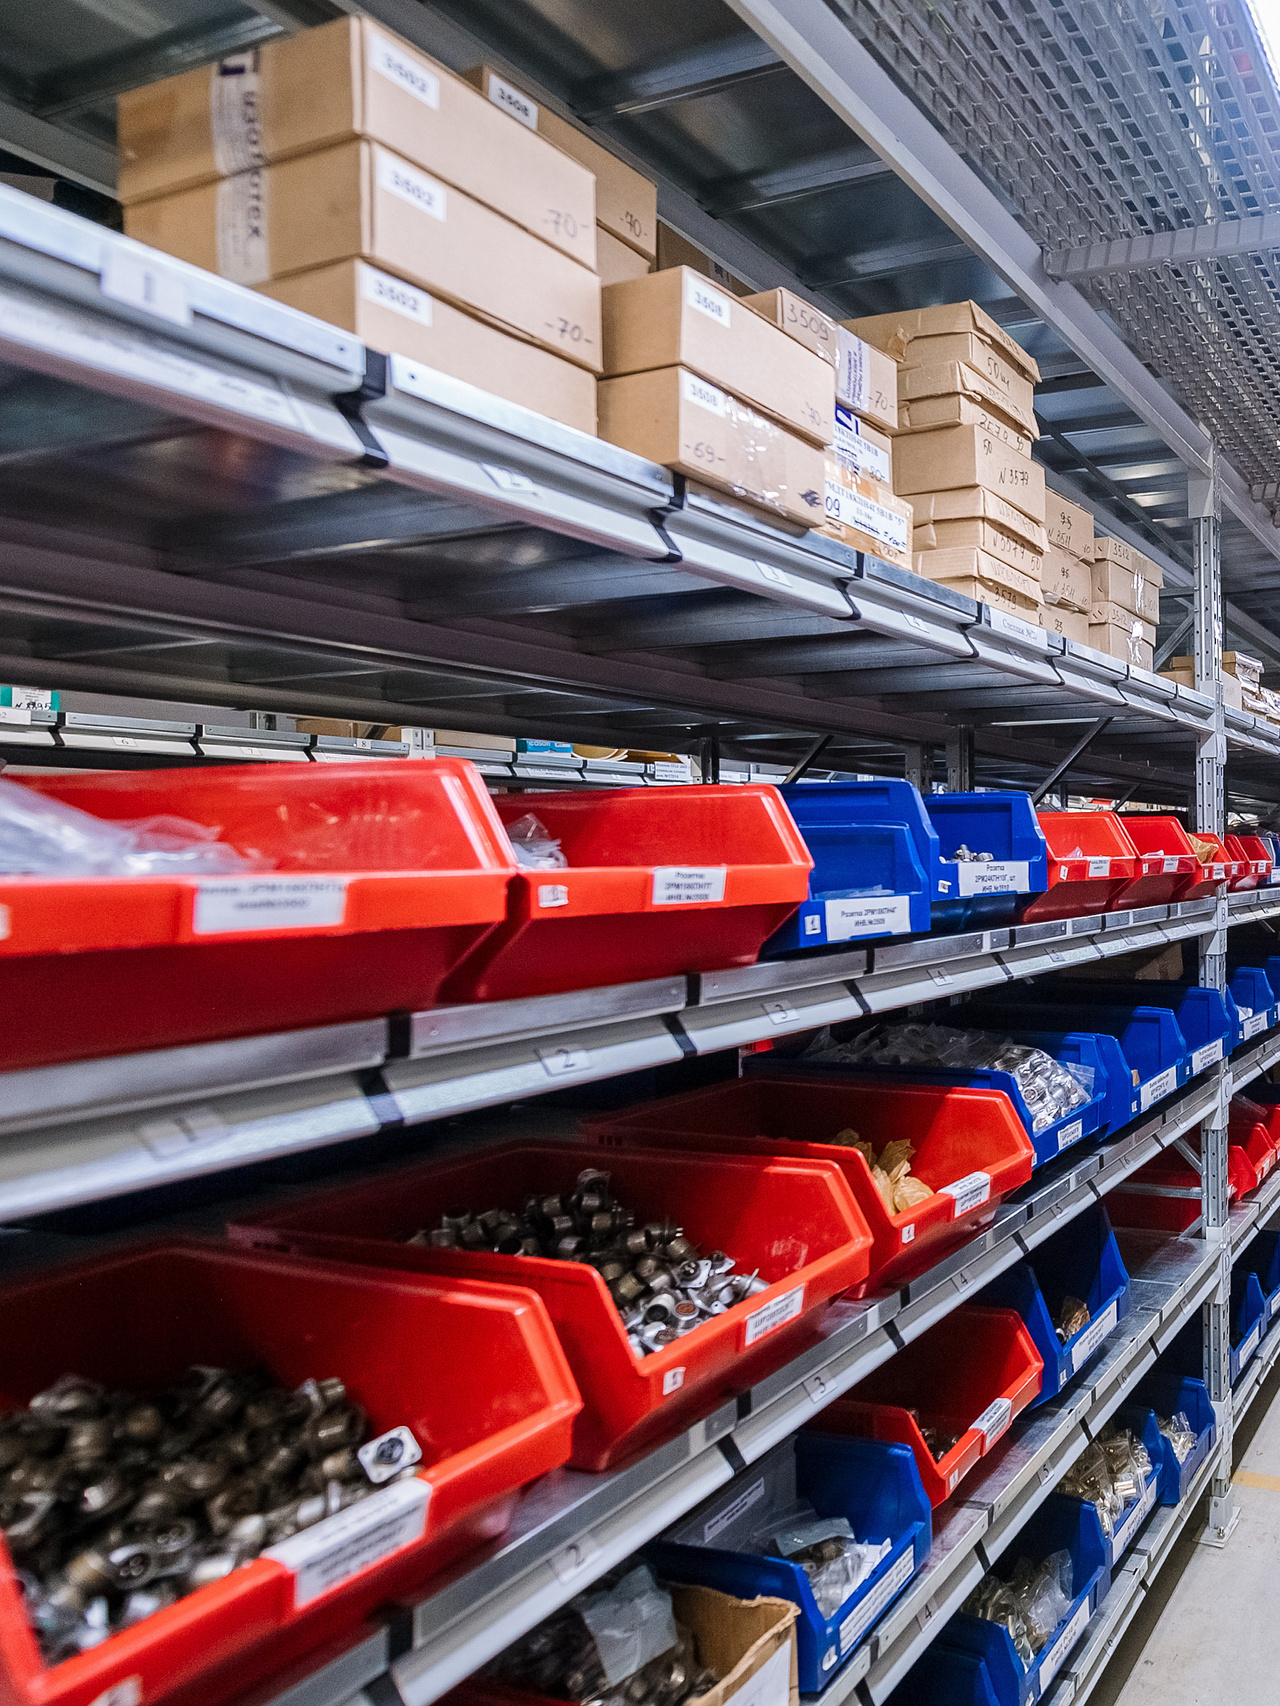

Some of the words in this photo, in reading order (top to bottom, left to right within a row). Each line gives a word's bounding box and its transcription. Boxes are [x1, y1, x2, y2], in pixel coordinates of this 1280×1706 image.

[786, 303, 830, 341] 3509
[775, 1003, 788, 1019] 3
[555, 1047, 577, 1068] 2
[959, 1272, 968, 1284] 4
[814, 1376, 826, 1394] 3
[565, 1544, 584, 1568] 2
[925, 1604, 933, 1619] 4
